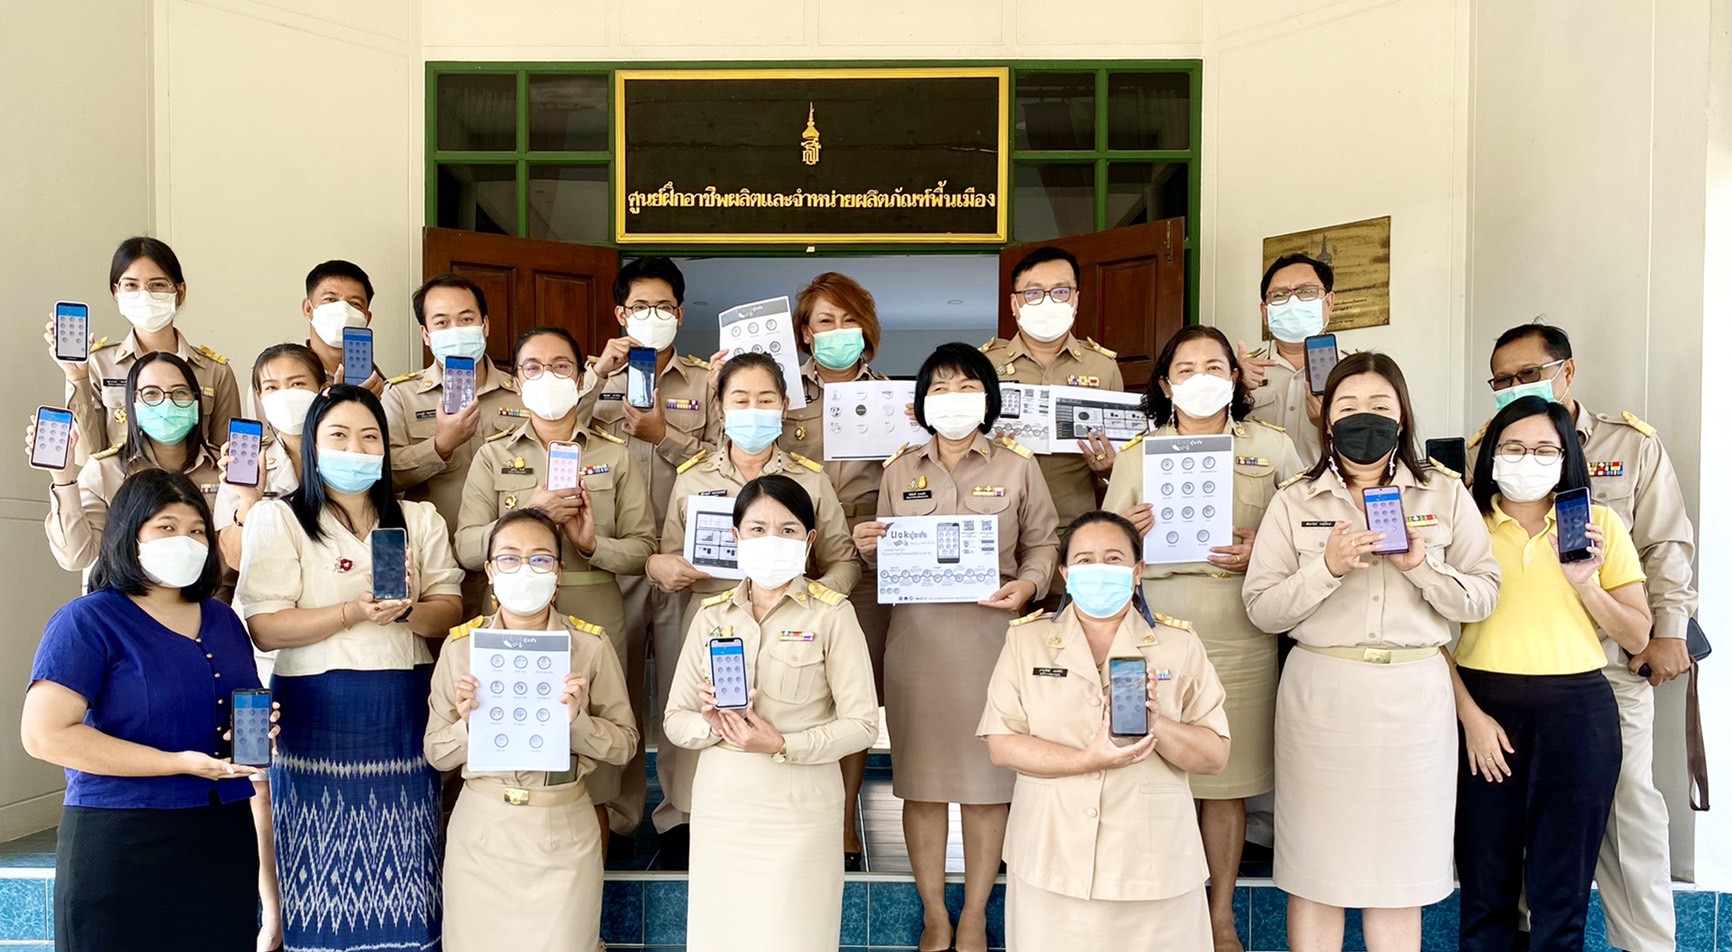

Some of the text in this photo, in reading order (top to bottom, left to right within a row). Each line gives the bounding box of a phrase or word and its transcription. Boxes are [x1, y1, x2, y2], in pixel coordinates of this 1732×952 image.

[628, 180, 996, 214] ศูนย์ฝึกอาชีพผลิตและจำหน่ายผลิตภัณฑ์พื้นเมือง
